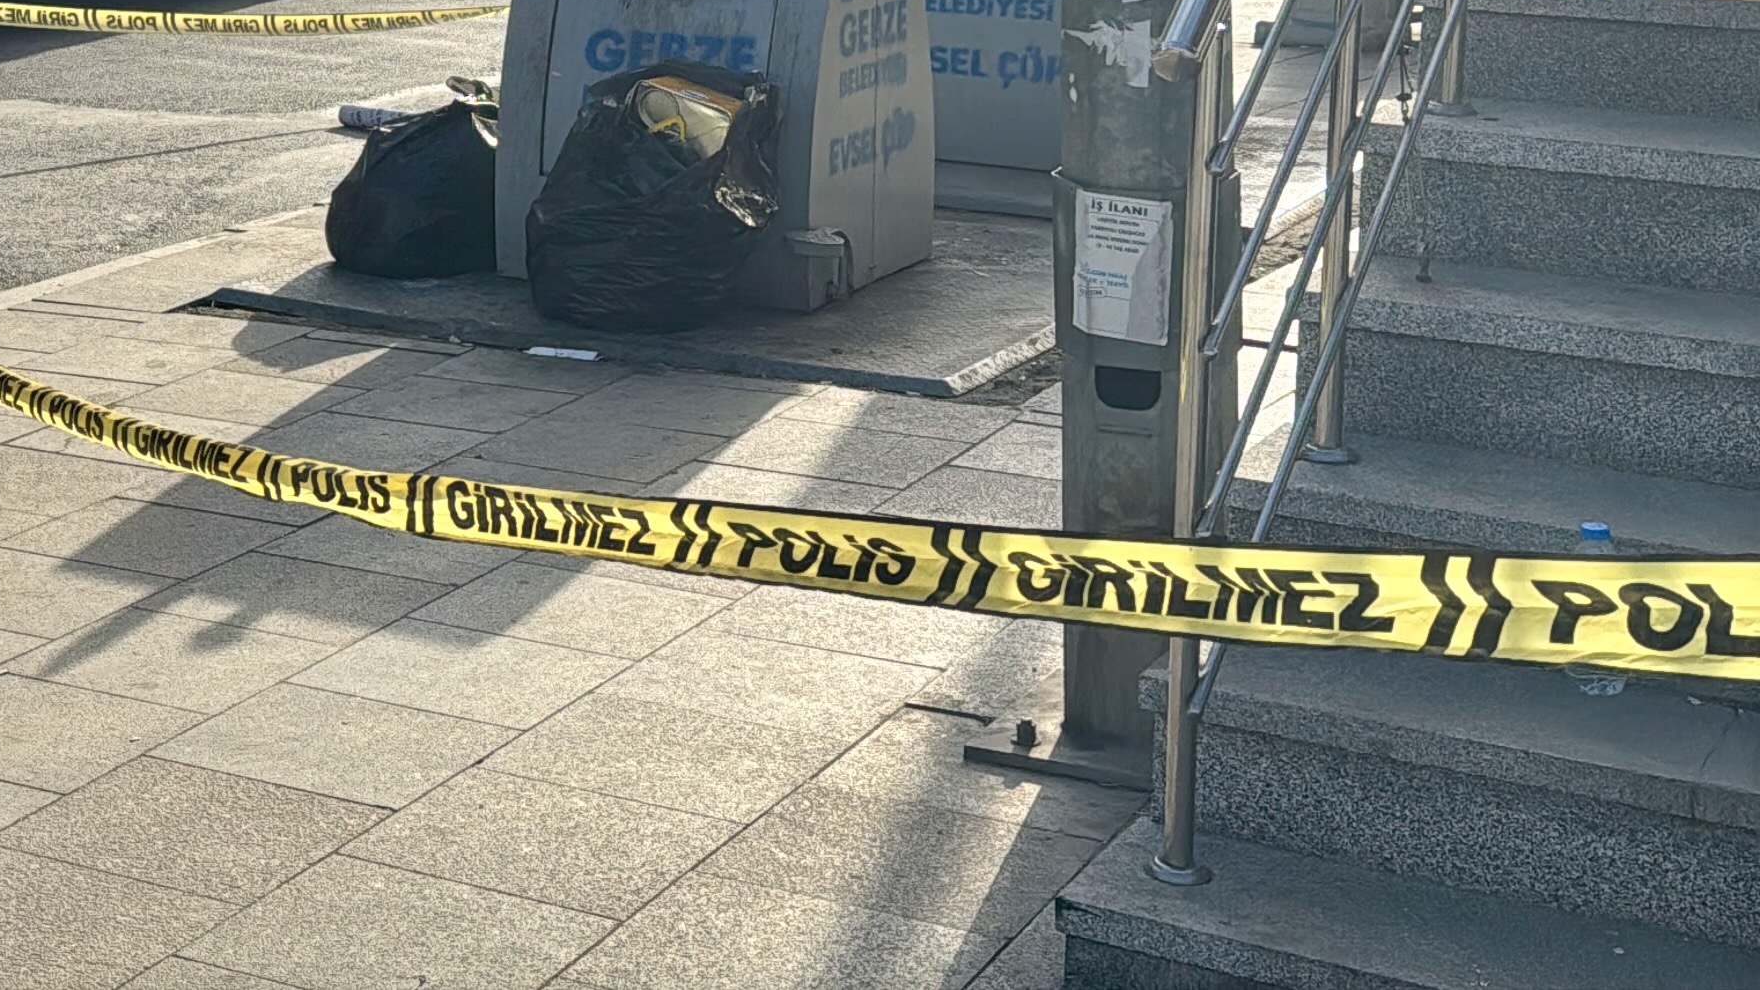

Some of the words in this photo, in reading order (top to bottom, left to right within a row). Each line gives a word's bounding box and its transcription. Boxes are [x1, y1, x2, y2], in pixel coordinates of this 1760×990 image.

[930, 45, 989, 79] SEL
[1091, 197, 1103, 212] İŞ
[1108, 201, 1149, 217] İLANI
[49, 391, 106, 441] POLİS
[135, 424, 257, 485] GİRİLMEZ
[290, 461, 391, 515] POLİS
[446, 482, 656, 556] GİRİLMEZ
[734, 520, 918, 587] POLİS
[1007, 551, 1398, 634] GİRİLMEZ
[1531, 577, 1760, 657] POL
